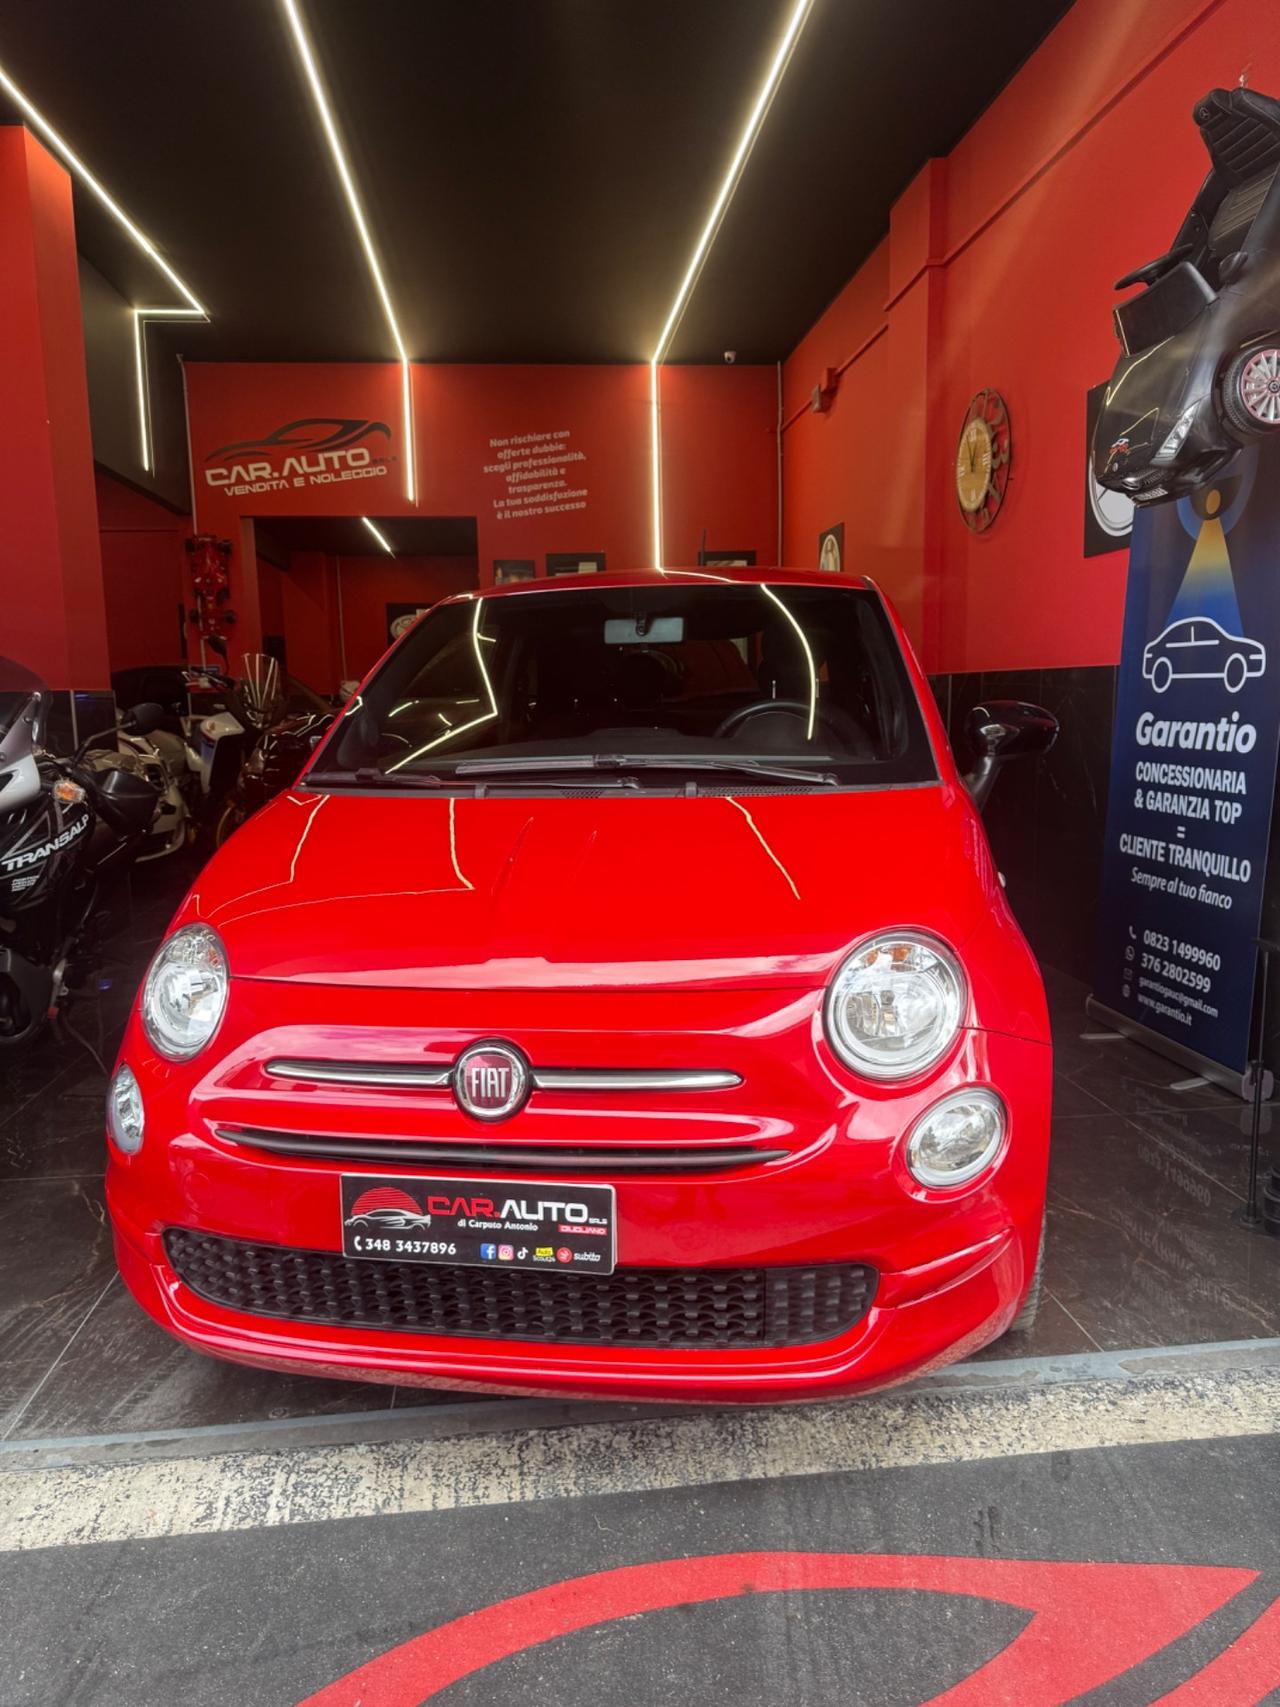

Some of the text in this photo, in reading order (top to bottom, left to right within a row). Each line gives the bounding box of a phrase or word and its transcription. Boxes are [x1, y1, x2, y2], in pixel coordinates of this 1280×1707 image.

[489, 430, 570, 448] Non rischiare con
[497, 447, 531, 460] offerte
[204, 447, 371, 486] CAR.AUTO
[224, 465, 387, 496] VENDITA E NOLEGGIO
[483, 461, 511, 473] scegli
[506, 467, 567, 483] affidabilità e
[493, 489, 588, 508] La tua soddisfazione
[508, 480, 568, 494] trasparenza.
[496, 501, 587, 519] è il nostro successo
[1135, 710, 1257, 754] Garantio
[1135, 761, 1247, 795] CONCESSIONARIA
[1134, 788, 1243, 824] & GARANZIA TOP
[1, 813, 90, 872] TRANSALP
[1119, 833, 1252, 883] CLIENTE TRANQUILLO
[1130, 866, 1233, 909] Sempre al tuo fianco
[1143, 929, 1221, 971] 0823 1499960
[1140, 952, 1211, 993] 376 2802599
[1137, 993, 1192, 1026] www.garantio.it
[471, 1067, 510, 1098] FIAT
[427, 1195, 588, 1223] CAR.AUTO
[457, 1219, 539, 1232] di Carputo Antonio
[365, 1238, 457, 1255] 348 3437896
[573, 1252, 601, 1262] subito
